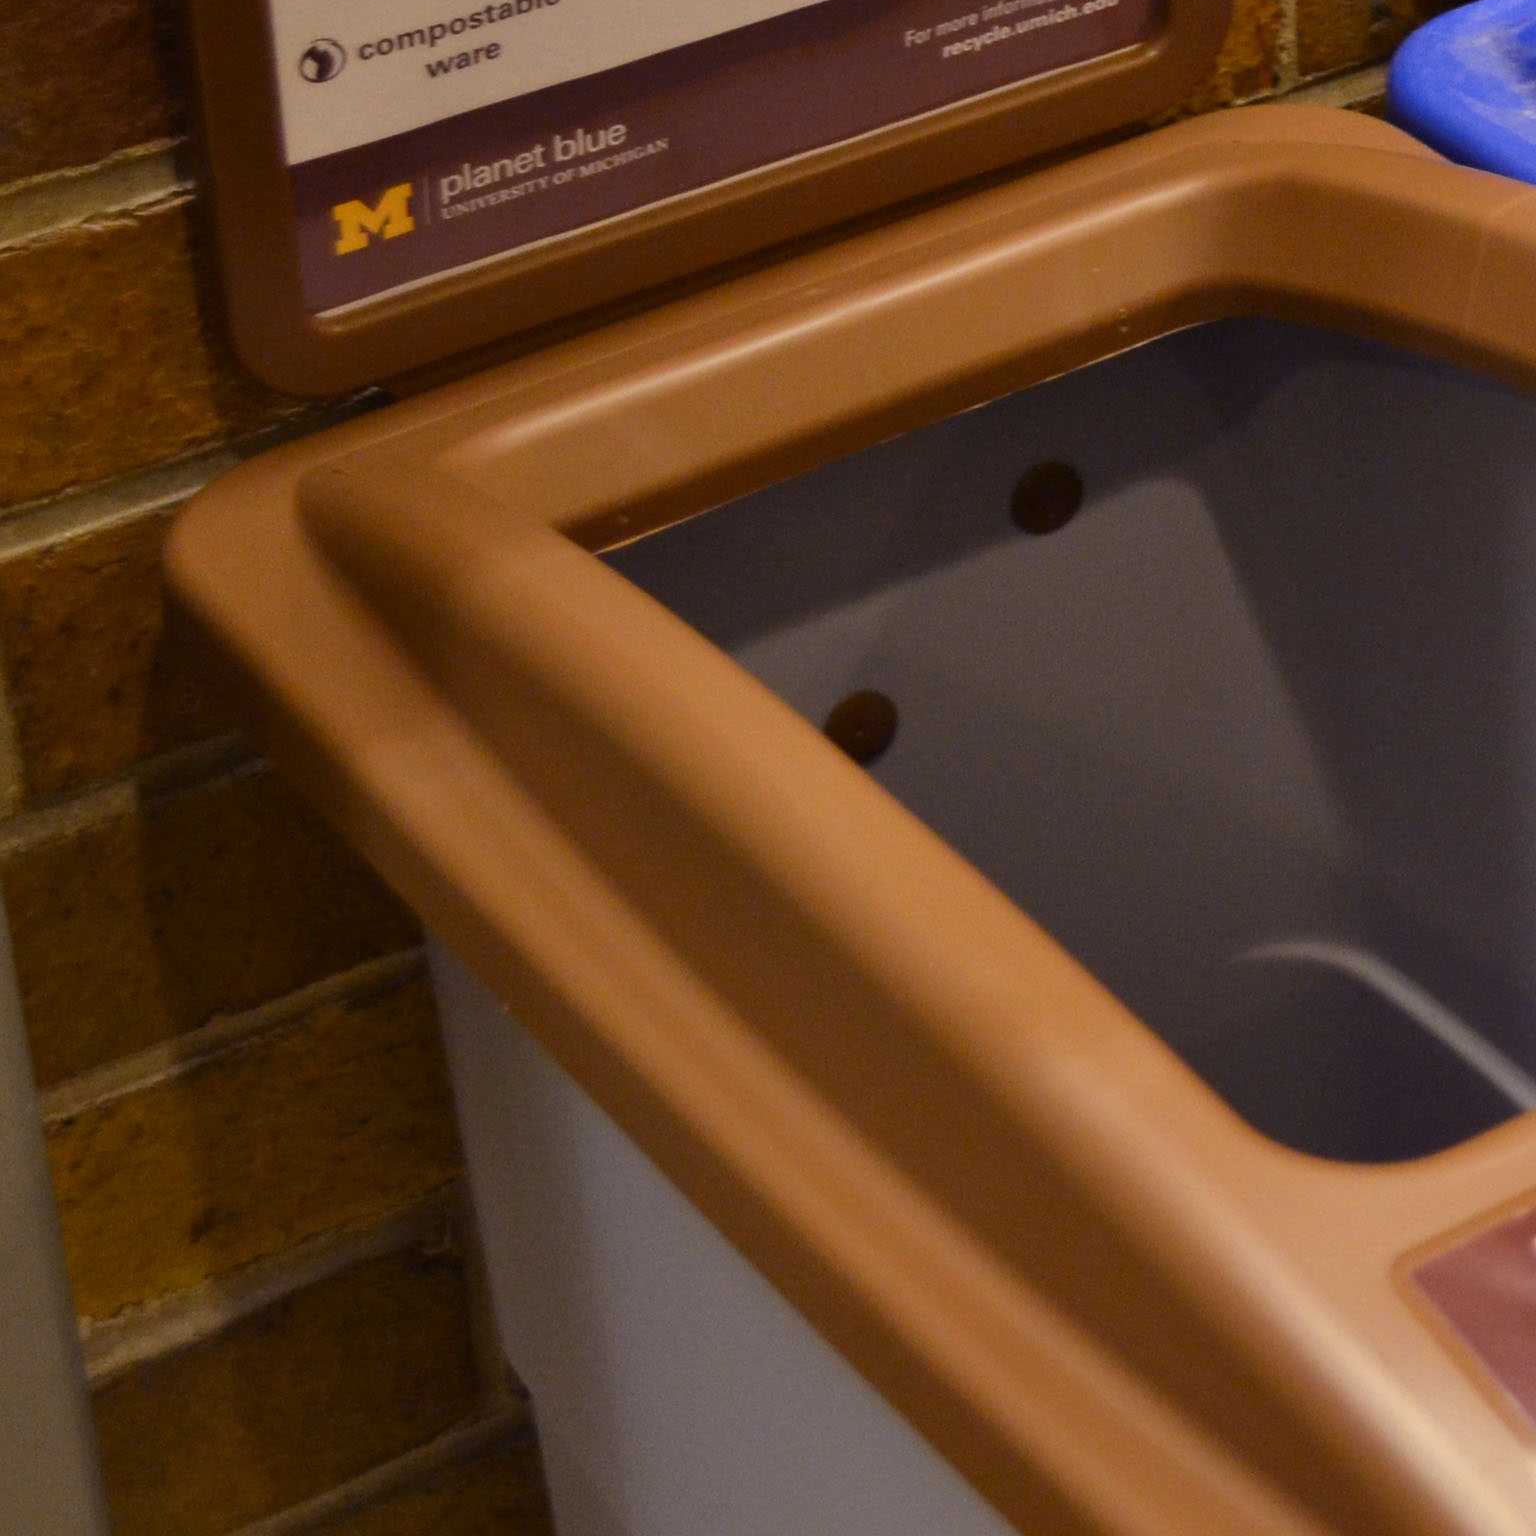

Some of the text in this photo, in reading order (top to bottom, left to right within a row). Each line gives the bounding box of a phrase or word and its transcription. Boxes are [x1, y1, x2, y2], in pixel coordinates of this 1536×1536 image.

[423, 40, 502, 79] ware
[904, 28, 932, 48] For
[935, 13, 979, 37] more
[332, 123, 628, 257] M planet blue
[440, 137, 670, 220] UNIVERSITY OF MICHIGAN
